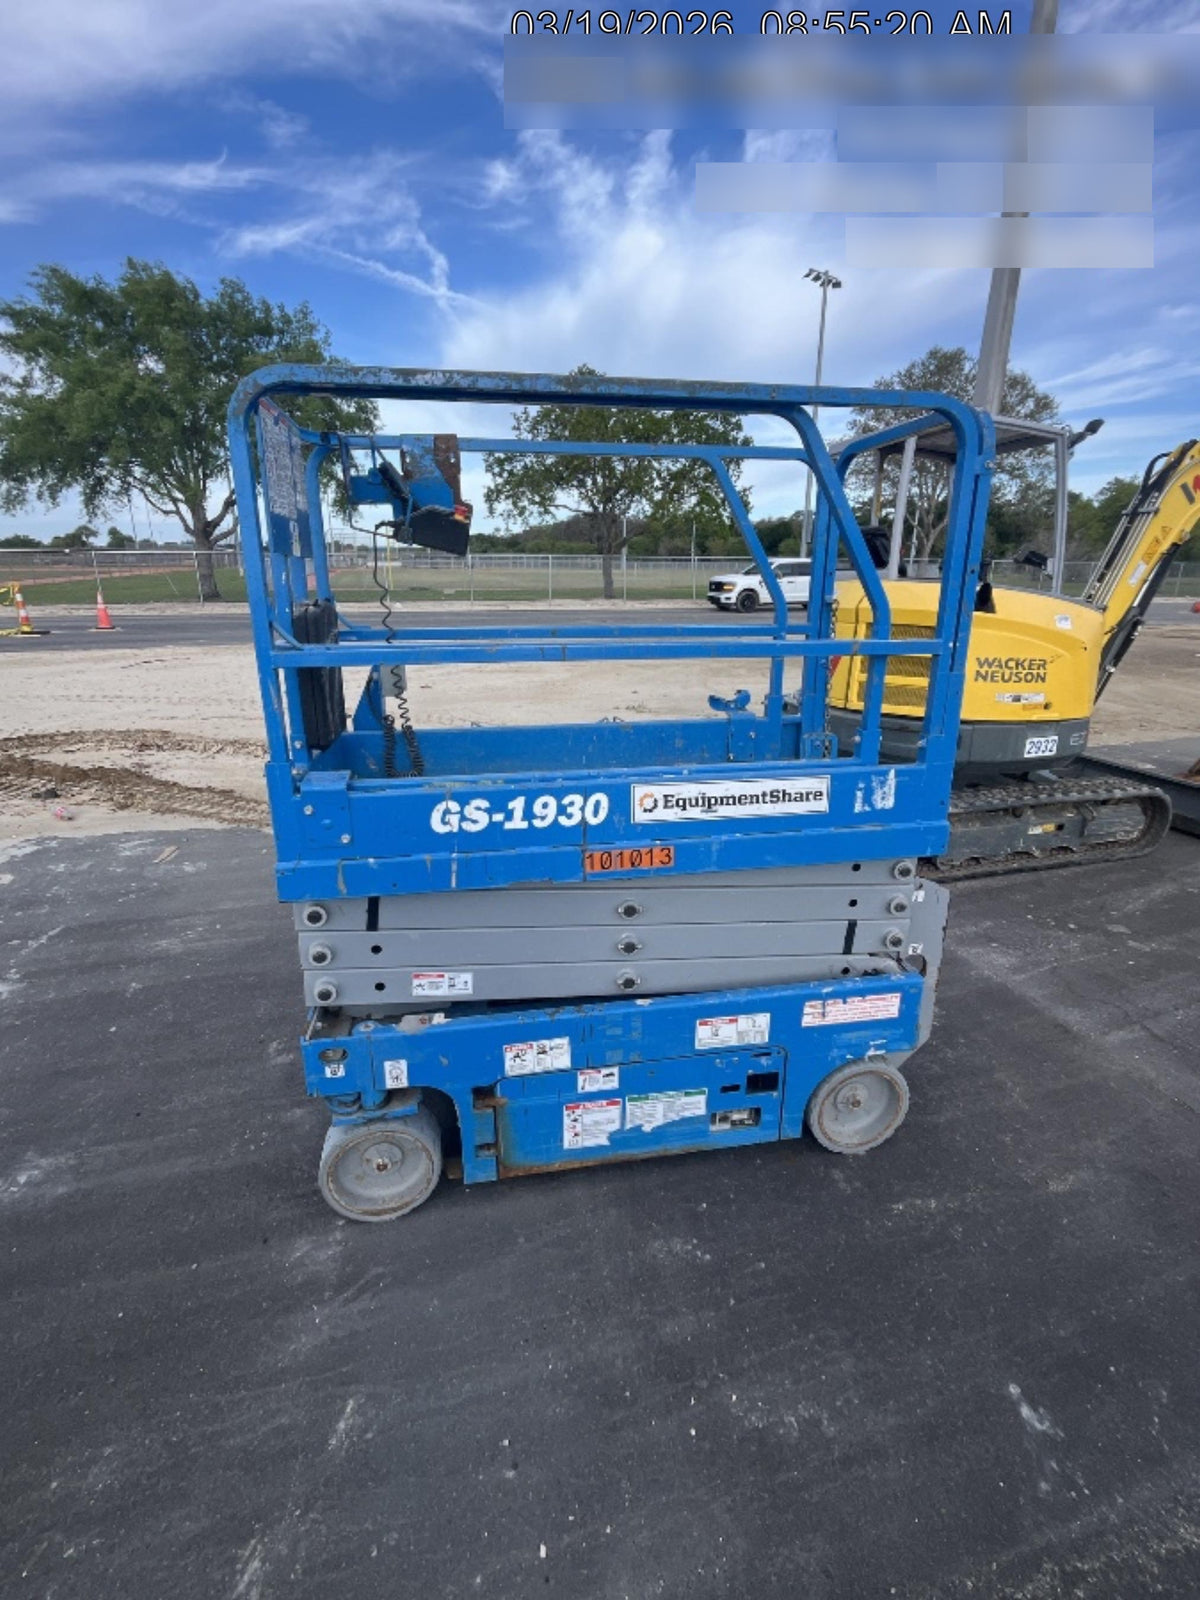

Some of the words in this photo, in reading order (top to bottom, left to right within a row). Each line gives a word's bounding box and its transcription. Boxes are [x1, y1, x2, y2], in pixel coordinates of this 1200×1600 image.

[976, 657, 1047, 671] WACKER
[974, 670, 1047, 683] NEUSON
[1026, 739, 1057, 755] 2932
[662, 788, 824, 811] EquipmentShare
[430, 792, 609, 834] GS-1930
[585, 847, 672, 870] 101013
